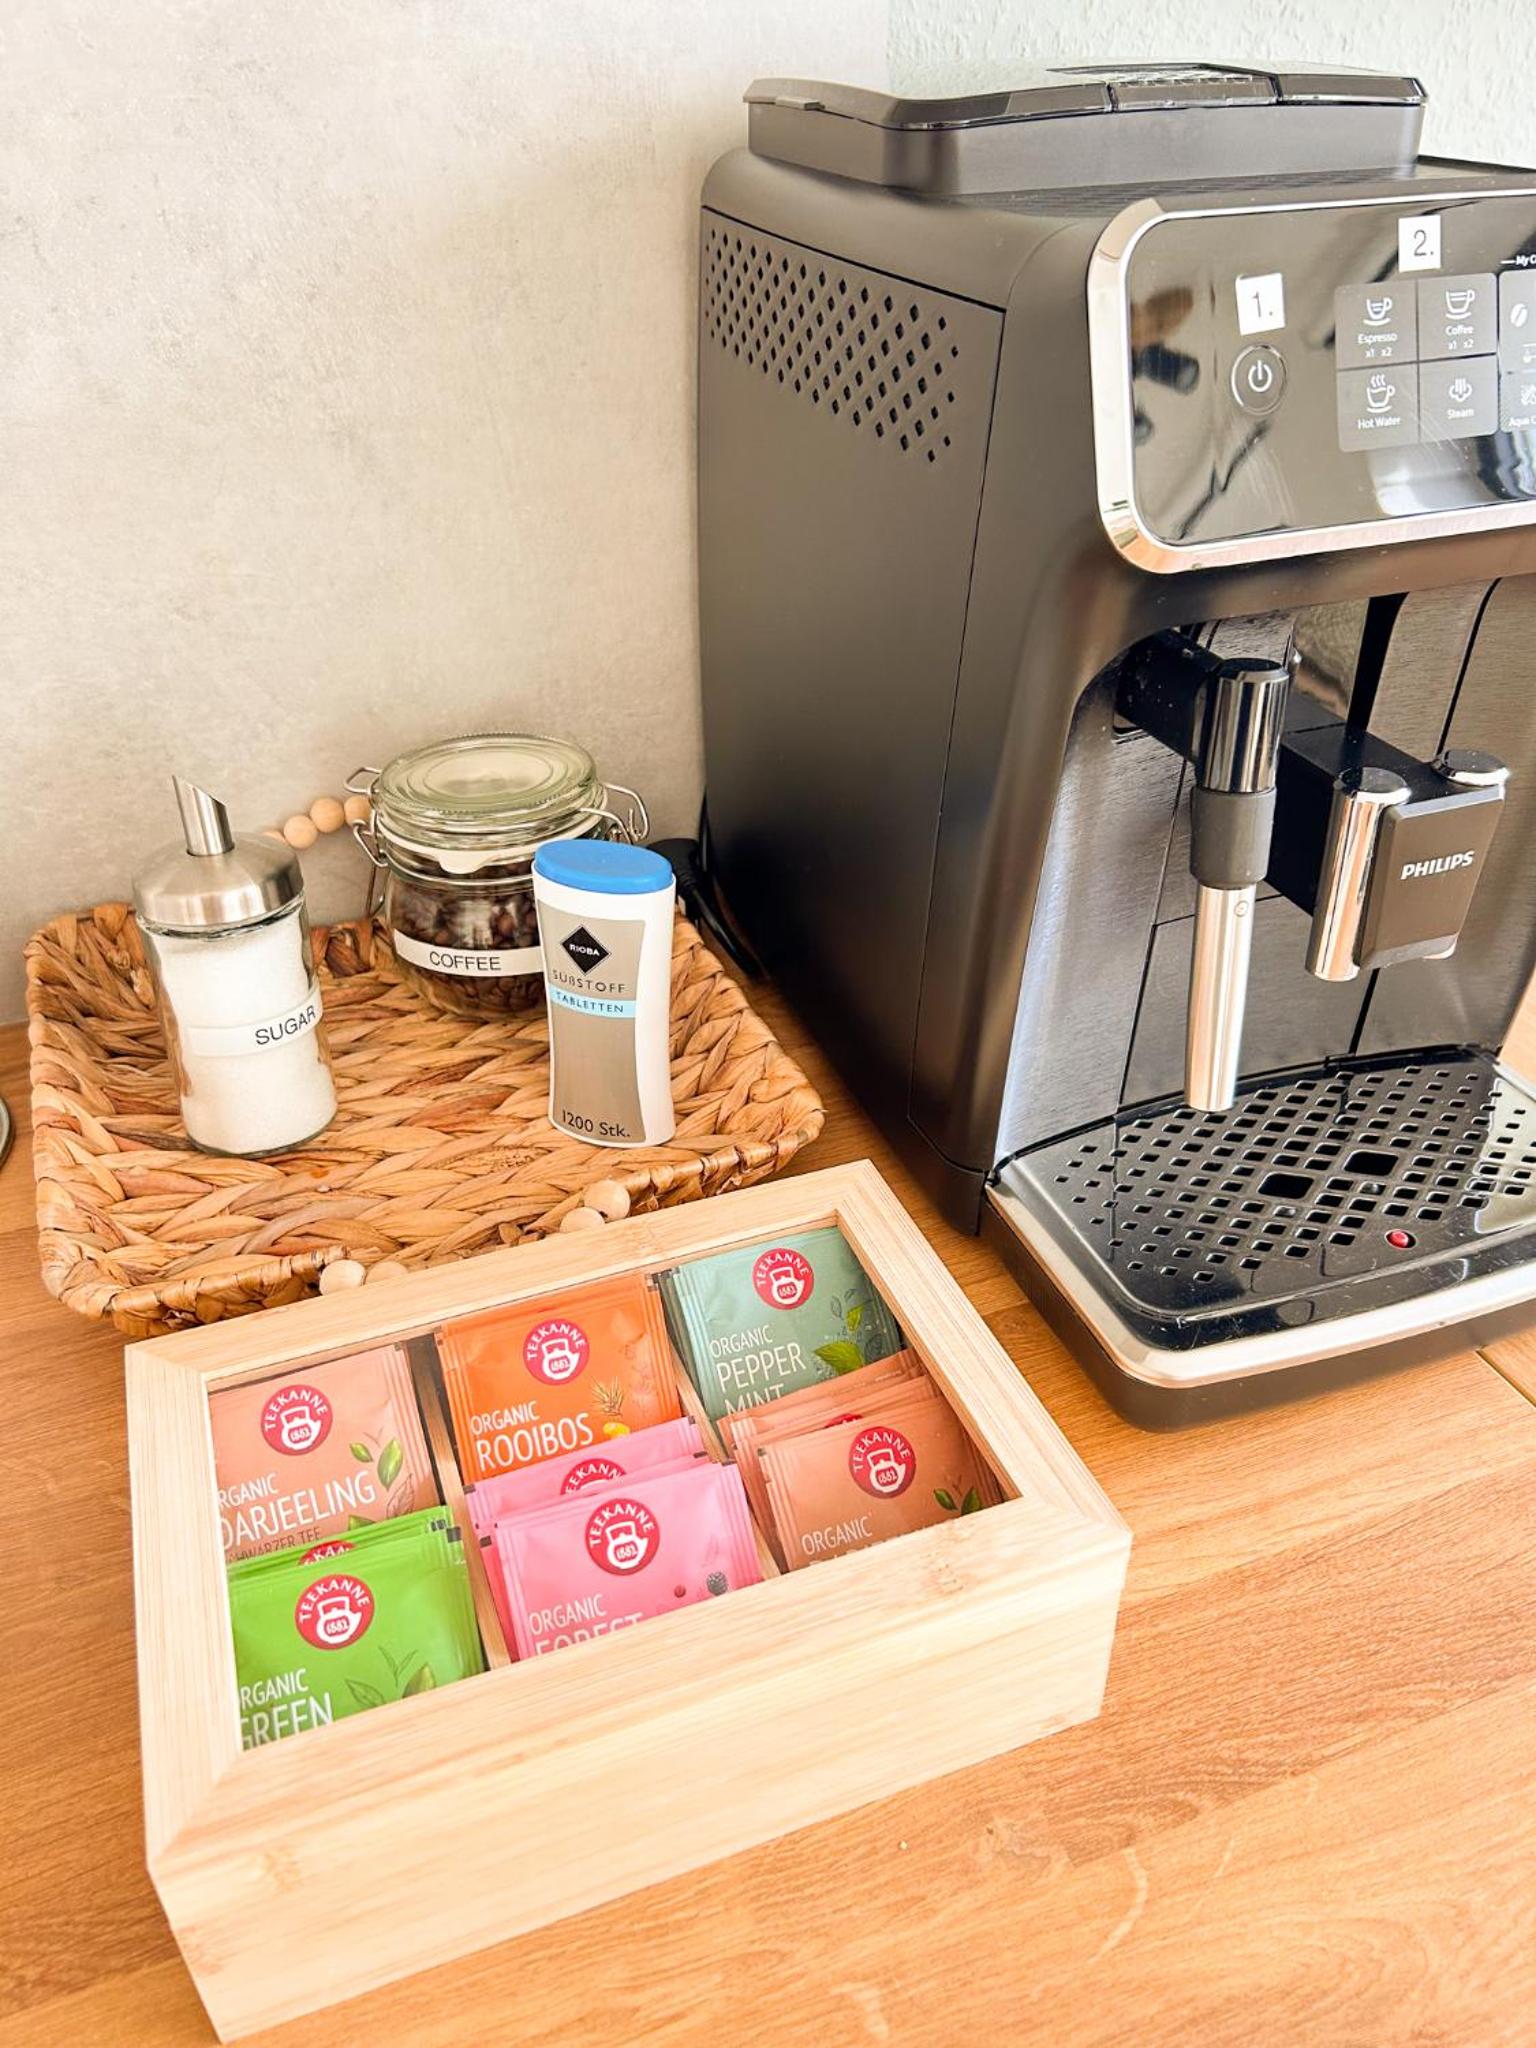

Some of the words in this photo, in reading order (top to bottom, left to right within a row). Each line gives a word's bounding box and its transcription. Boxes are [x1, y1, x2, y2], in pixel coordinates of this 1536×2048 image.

[1413, 229, 1435, 258] 2.
[1252, 291, 1274, 318] 1.
[1357, 332, 1398, 346] Espresso
[1445, 325, 1474, 336] Coffee
[1357, 418, 1376, 430] Hot
[1377, 415, 1402, 428] Water
[1447, 408, 1475, 420] Steam
[1400, 850, 1476, 881] PHILIPS
[429, 950, 502, 972] COFFEE
[568, 943, 600, 957] RIOBA
[556, 991, 624, 1013] TABLETTEN
[254, 1004, 316, 1046] SUGAR
[561, 1109, 594, 1133] 1200
[599, 1121, 631, 1138] Stk.
[756, 1251, 812, 1288] TEEKANNE
[526, 1323, 587, 1361] TEEKANNE
[709, 1324, 774, 1359] ORGANIC
[716, 1342, 807, 1393] PEPPER
[264, 1389, 329, 1432] TEEKANNE
[470, 1400, 540, 1436] ORGANIC
[476, 1412, 594, 1473] ROOIBOS
[854, 1431, 911, 1472] TEEKANNE
[218, 1473, 279, 1509] RGANIC
[589, 1503, 655, 1549] TEEKANNE
[801, 1516, 873, 1556] ORGANIC
[299, 1579, 371, 1624] TEEKANNE
[529, 1594, 607, 1636] ORGANIC
[240, 1668, 309, 1710] RGANIC
